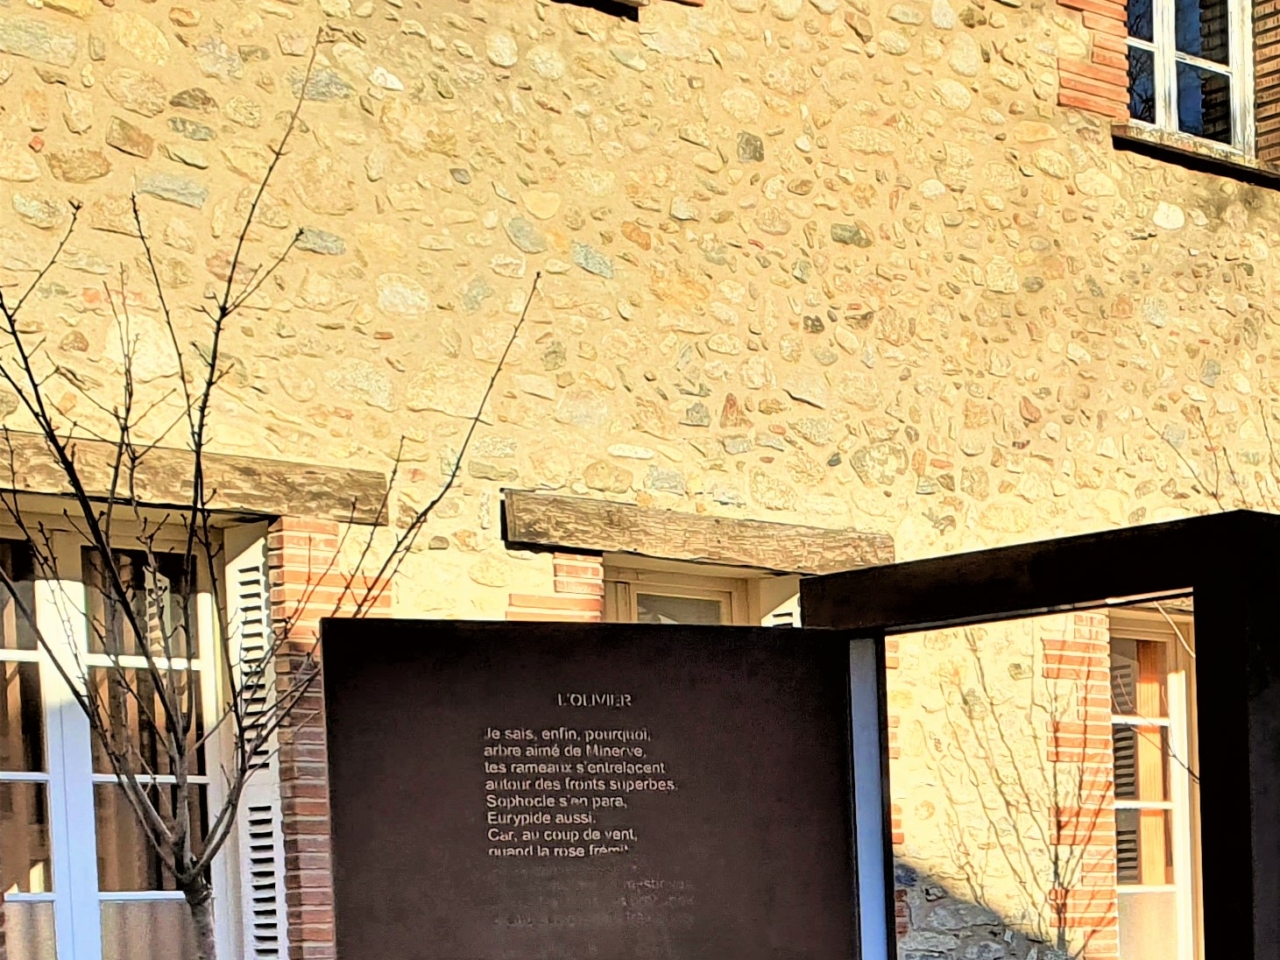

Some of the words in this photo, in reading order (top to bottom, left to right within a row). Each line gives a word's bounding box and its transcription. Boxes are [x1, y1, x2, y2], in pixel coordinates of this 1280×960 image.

[556, 692, 633, 707] L'OLIVIER
[484, 726, 501, 741] Je
[504, 727, 538, 742] sais,
[541, 726, 581, 742] enfin,
[584, 727, 652, 743] pourquoi,
[484, 743, 522, 757] arbre
[525, 743, 560, 757] aimé
[564, 743, 582, 757] de
[585, 743, 648, 759] Minerve,
[484, 761, 507, 774] tes
[510, 763, 572, 774] rameaux
[576, 761, 666, 774] s'entrelacent
[485, 778, 532, 791] autour
[535, 777, 561, 791] des
[565, 777, 606, 791] fronts
[486, 793, 555, 810] Sophocle
[558, 794, 588, 807] s'en
[592, 796, 628, 810] para,
[487, 810, 551, 827] Eurypide
[555, 811, 597, 824] aussi.
[487, 827, 518, 842] Car,
[522, 830, 539, 841] au
[543, 829, 580, 844] coup
[582, 827, 601, 841] de
[605, 828, 638, 843] vent,
